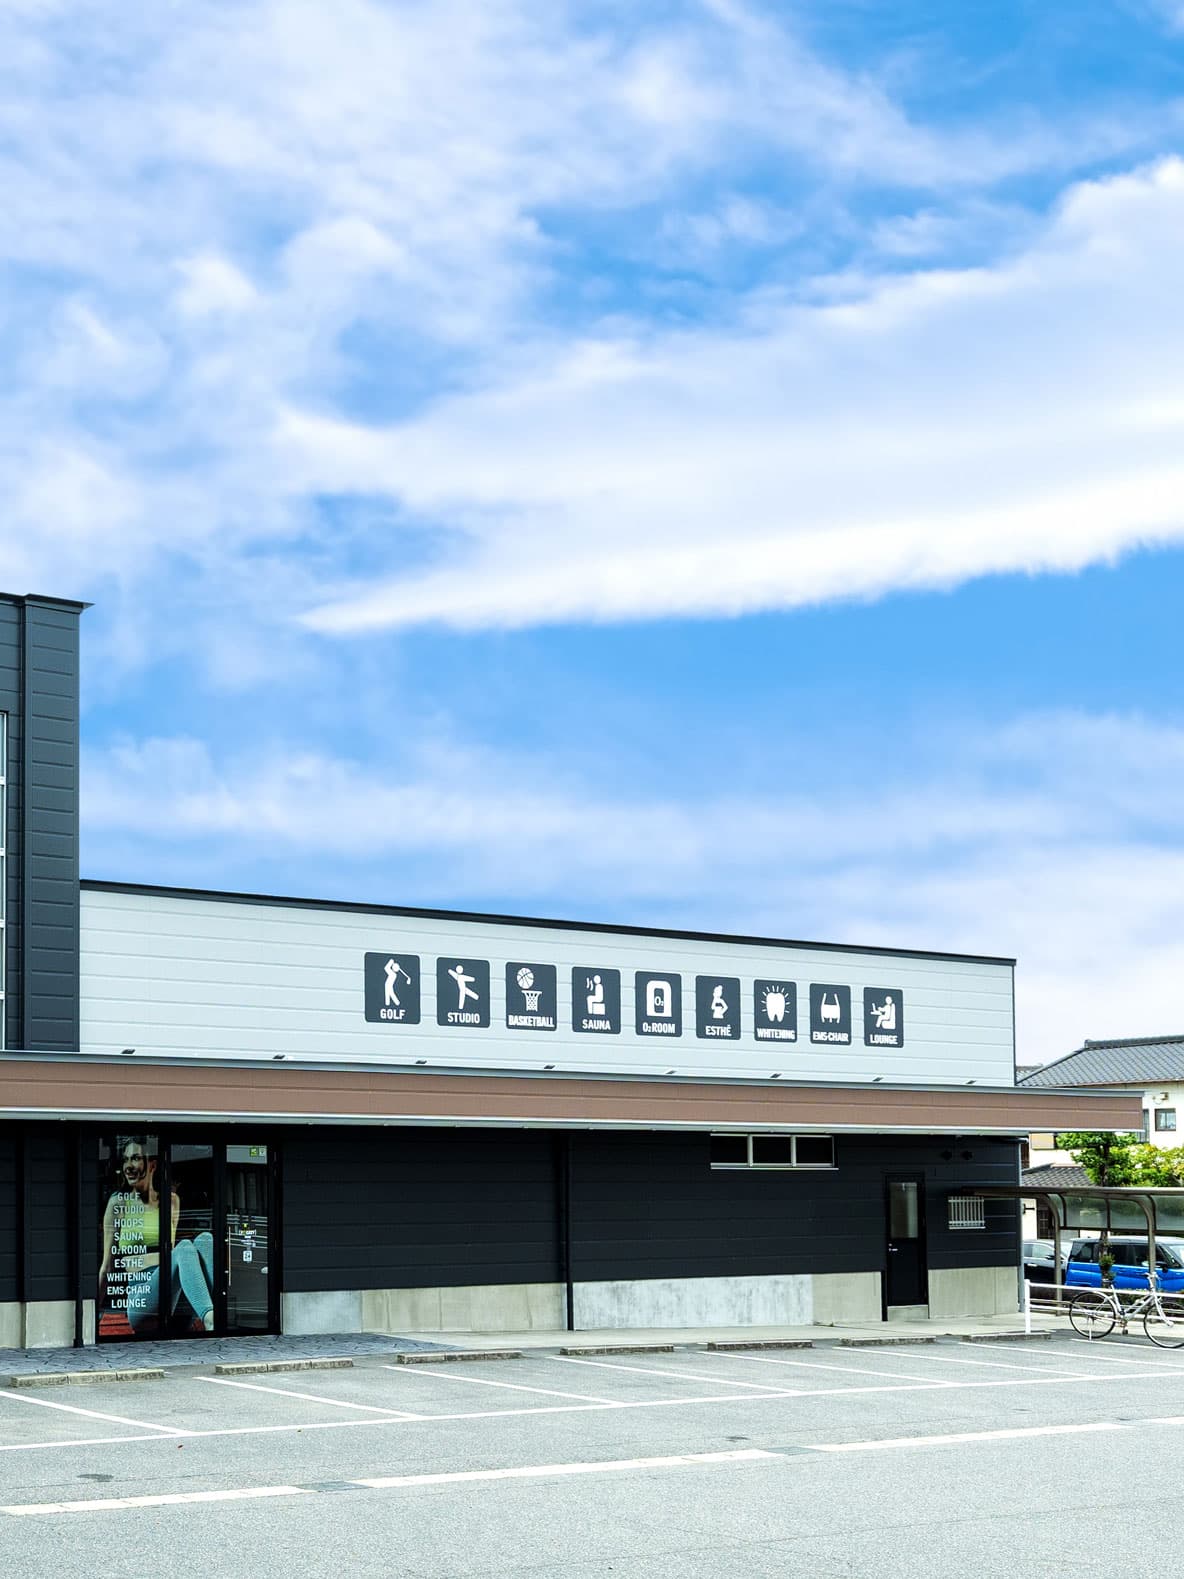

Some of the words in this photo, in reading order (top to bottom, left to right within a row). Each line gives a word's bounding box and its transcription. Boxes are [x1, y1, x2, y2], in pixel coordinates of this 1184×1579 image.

[380, 1009, 405, 1020] GOLF
[447, 1012, 480, 1024] STUDIO
[508, 1015, 554, 1028] BASKETBALL
[582, 1019, 611, 1031] SAUNA
[757, 1028, 795, 1040] WHITENING
[870, 1034, 898, 1045] LOUNGE
[117, 1192, 141, 1201] GOLF
[113, 1205, 145, 1215] STUDIO
[114, 1218, 144, 1228] HOOPS
[114, 1232, 144, 1241] SAUNA
[106, 1271, 152, 1282] WHITENING
[111, 1298, 147, 1309] LOUNGE
